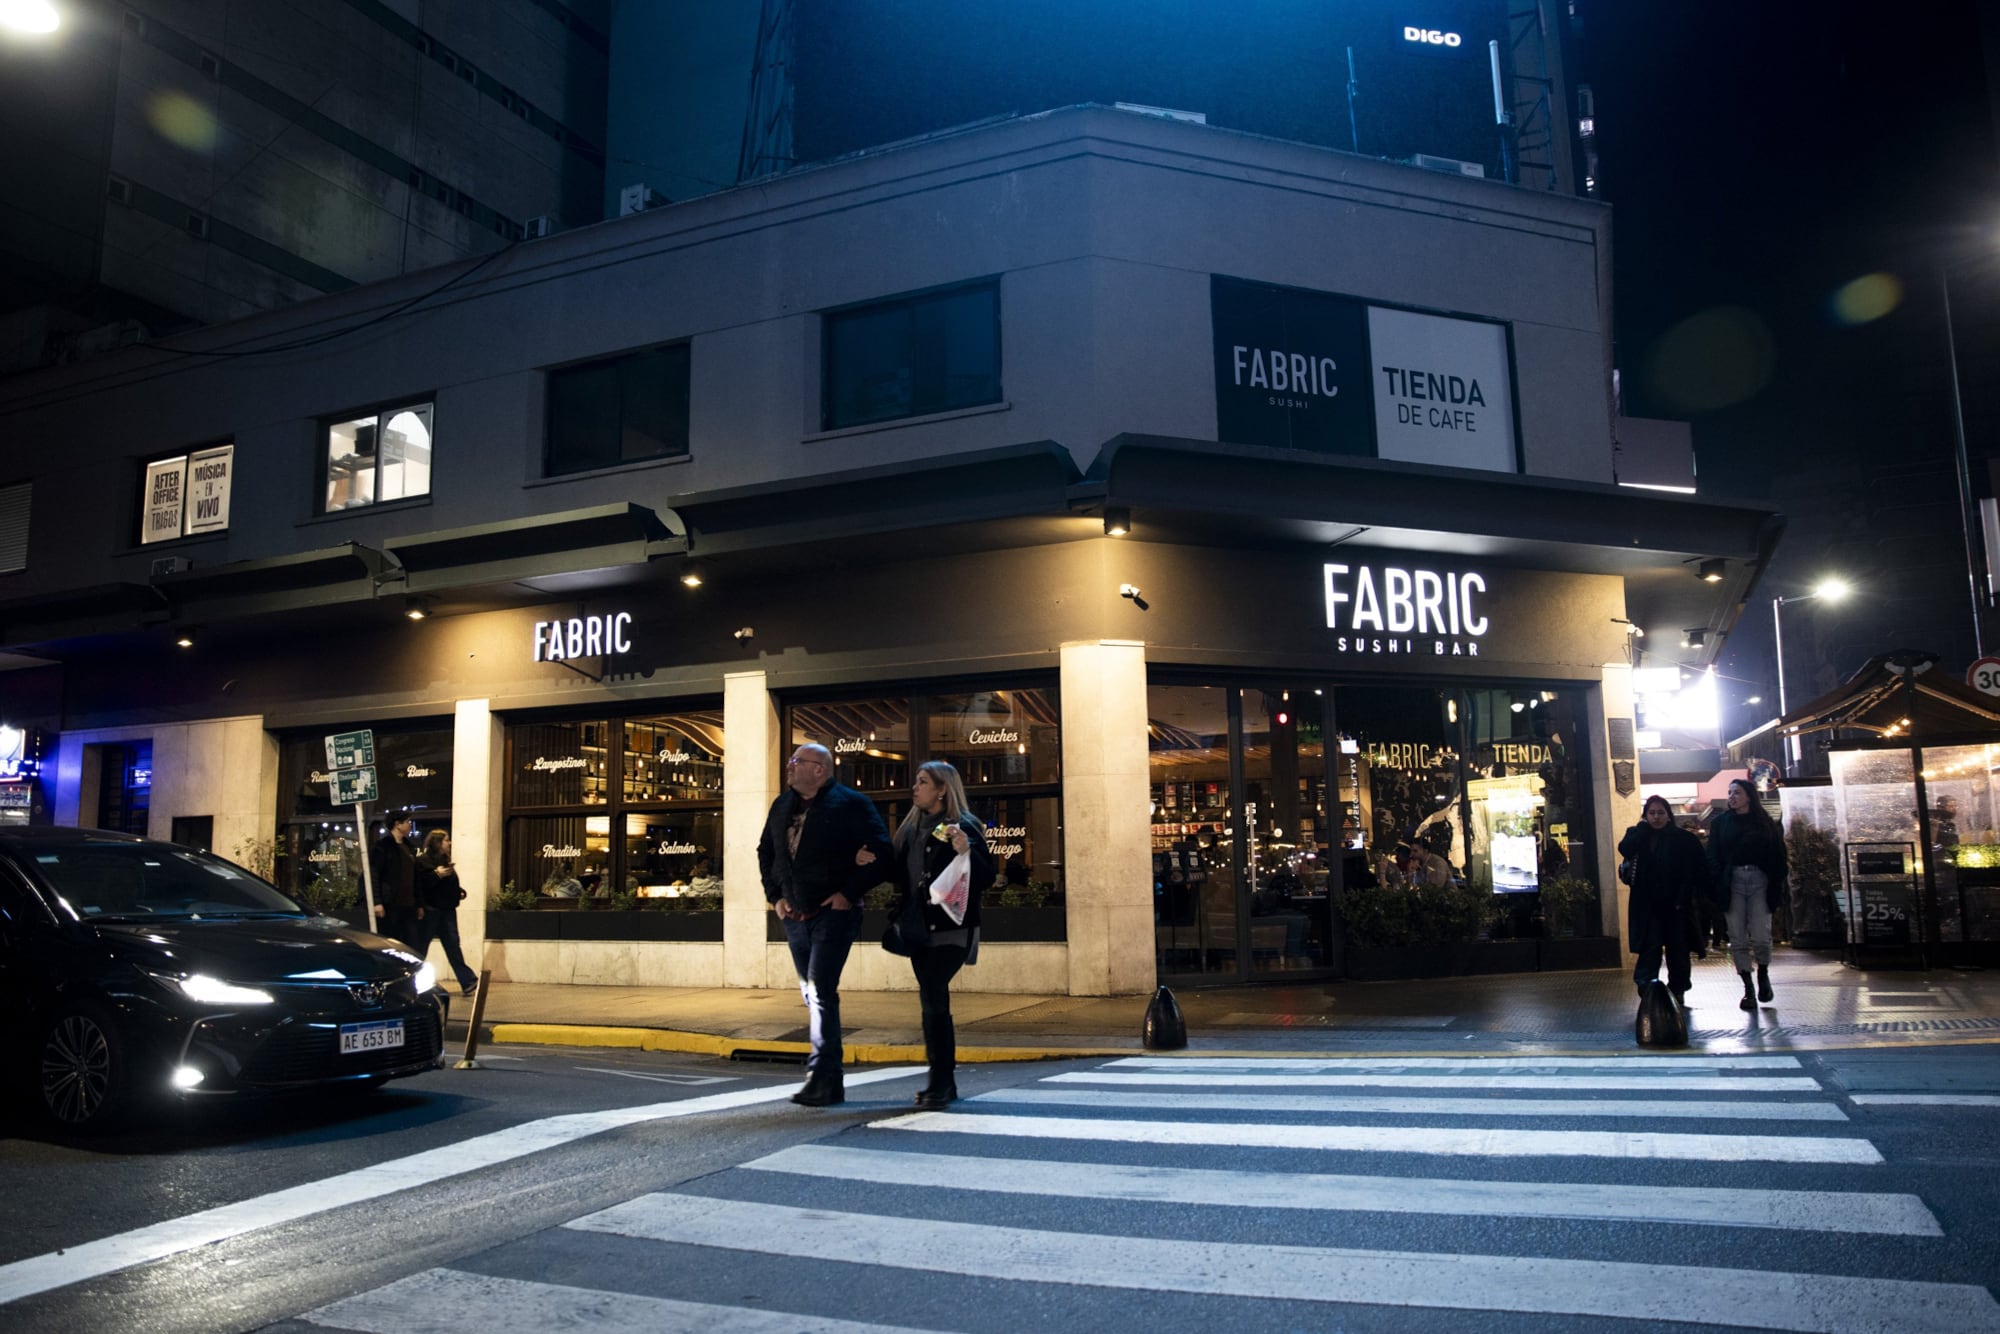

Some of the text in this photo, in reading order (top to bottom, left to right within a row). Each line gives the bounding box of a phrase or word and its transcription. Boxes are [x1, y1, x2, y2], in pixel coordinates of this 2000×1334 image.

[1404, 26, 1462, 47] DIGO
[1233, 345, 1339, 397] FABRIC
[1382, 366, 1487, 408] TIENDA
[1268, 396, 1309, 409] SUSHI
[1398, 403, 1477, 432] DE CAFE
[154, 470, 180, 490] AFTER
[194, 462, 226, 482] MÚSICA
[152, 487, 180, 505] OFFICE
[205, 482, 214, 497] EN
[197, 496, 220, 519] VIVO
[1323, 563, 1488, 636] FABRIC
[533, 611, 632, 662] FABRIC
[1337, 637, 1478, 657] SUSHI BAR
[1978, 671, 2000, 690] 30
[834, 738, 867, 753] Sushi
[969, 728, 1018, 745] Ceviches
[659, 748, 690, 765] Pulpo
[1368, 743, 1430, 769] FABRIC
[1492, 744, 1553, 764] TIENDA
[533, 756, 588, 773] Langostinos
[542, 844, 582, 858] Tiraditos
[658, 841, 697, 855] Salmón
[986, 840, 1023, 860] Fuego
[1866, 903, 1905, 921] 25%
[344, 1034, 358, 1051] AE
[363, 1031, 384, 1047] 653
